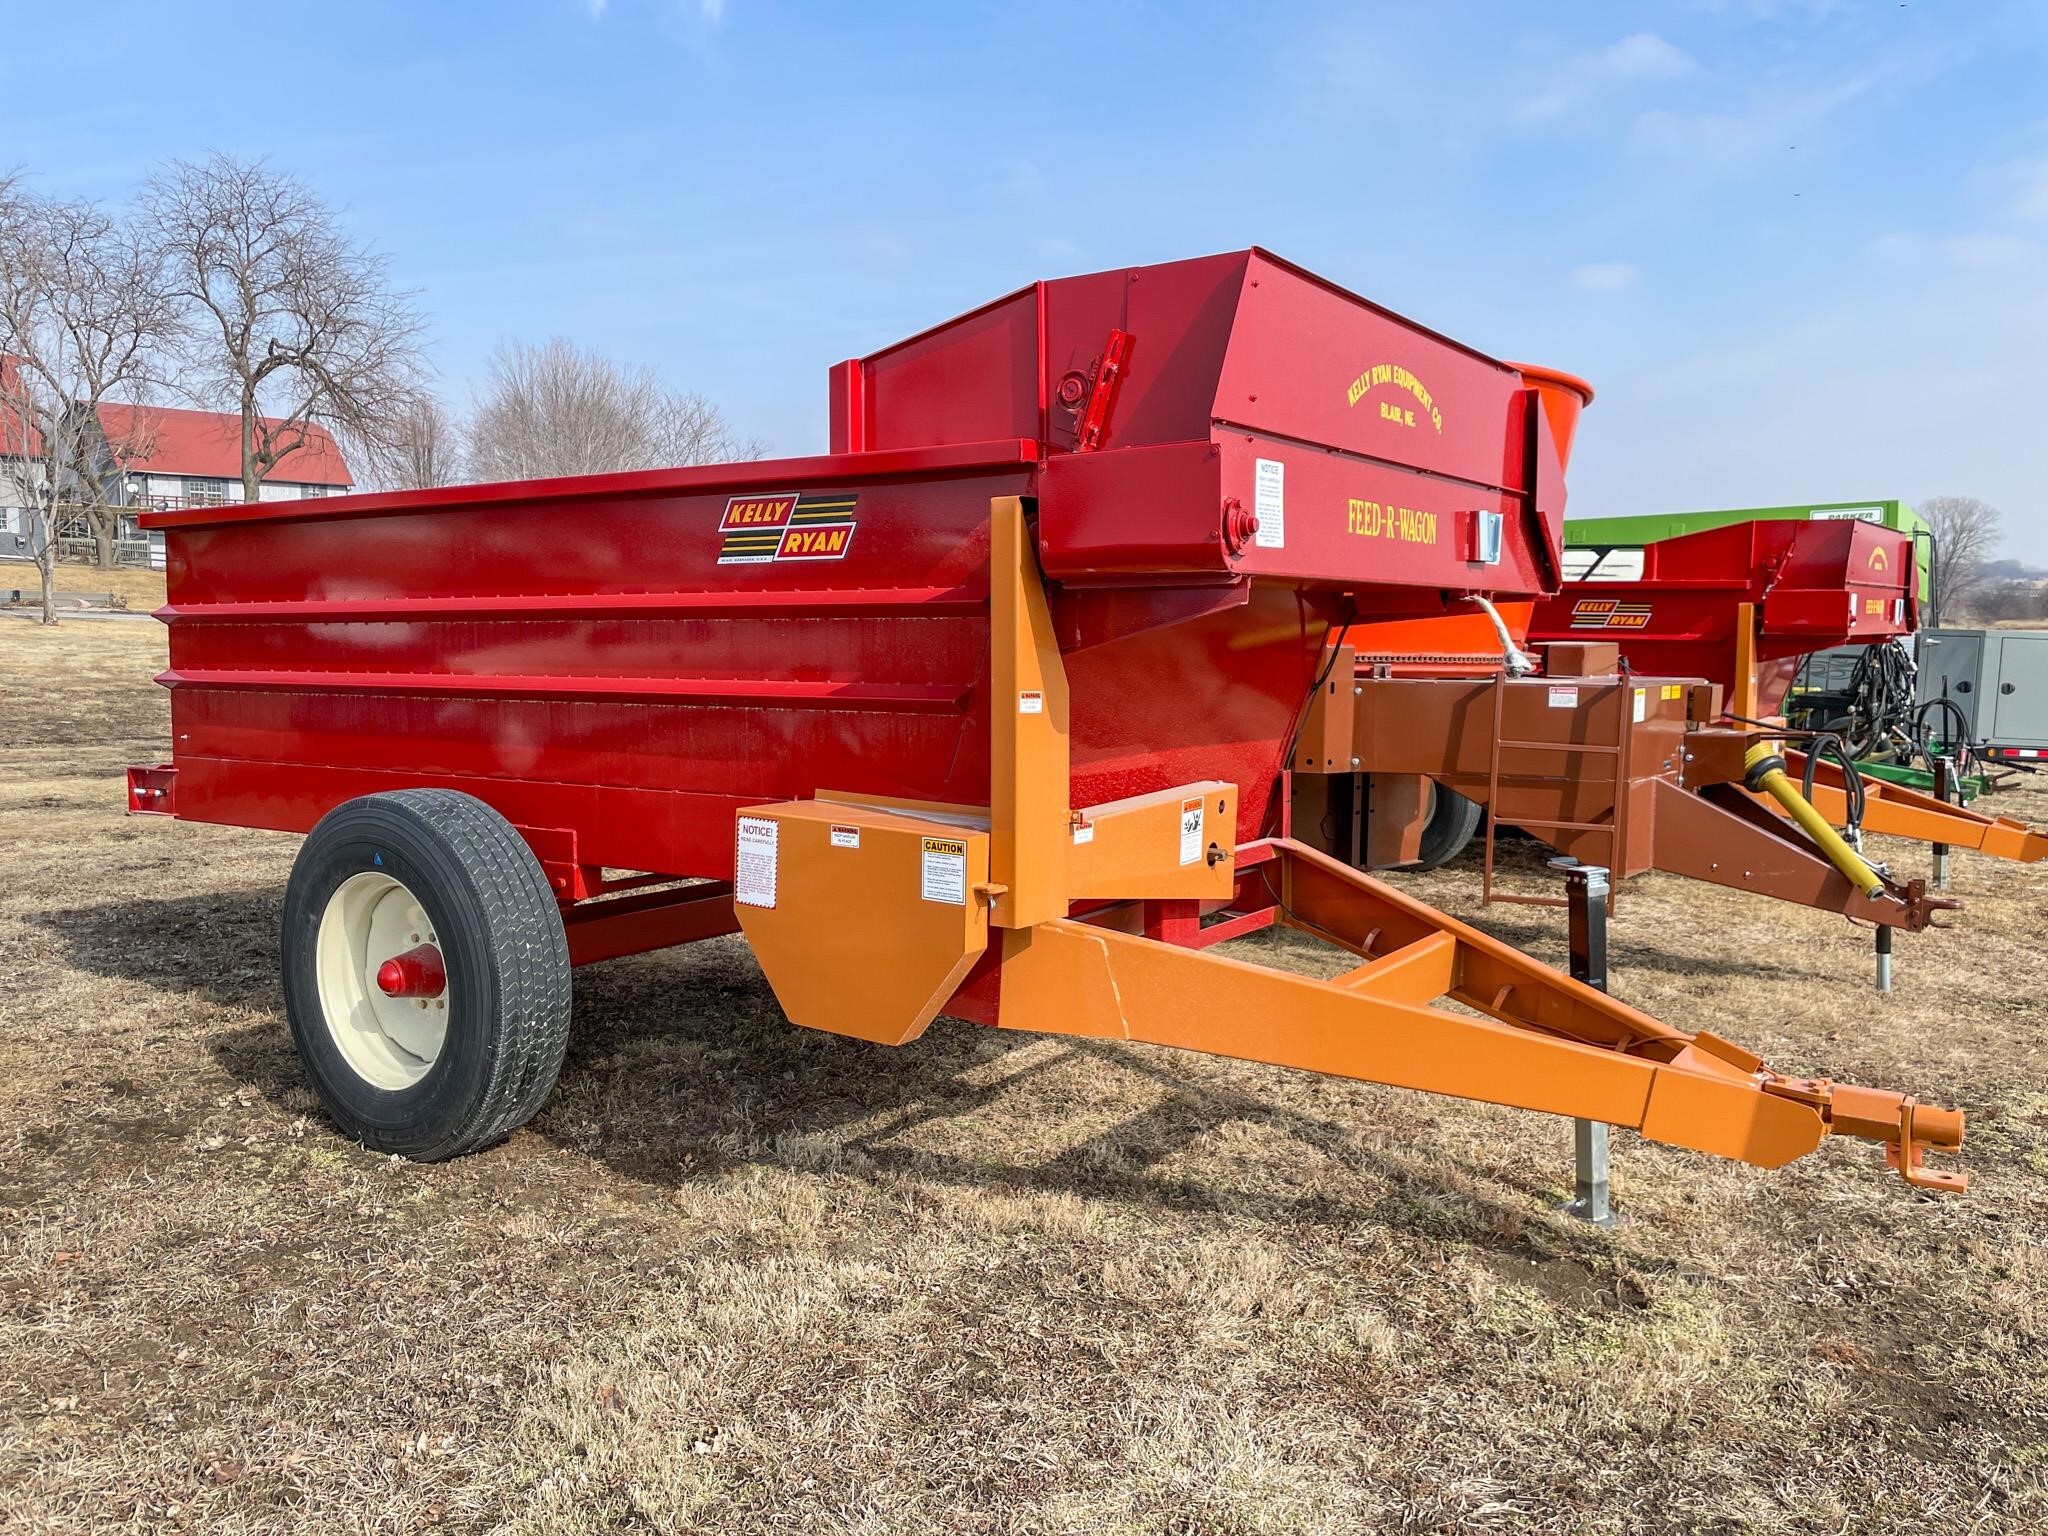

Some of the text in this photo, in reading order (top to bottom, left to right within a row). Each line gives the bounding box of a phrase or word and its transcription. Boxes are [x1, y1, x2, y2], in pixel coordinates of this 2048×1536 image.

[1347, 370, 1371, 408] KELLY
[1372, 364, 1392, 386] RYAN
[1393, 365, 1433, 412] EQUIPMENT
[1381, 401, 1417, 428] BLAIR, NE.
[728, 501, 789, 524] KELLY
[1348, 498, 1438, 545] FEED-R-WAGON
[784, 531, 846, 553] RYAN
[1577, 602, 1614, 612] KELLY
[1609, 616, 1646, 625] RYAN
[743, 824, 774, 838] NOTICE!
[925, 841, 963, 854] CAUTION
